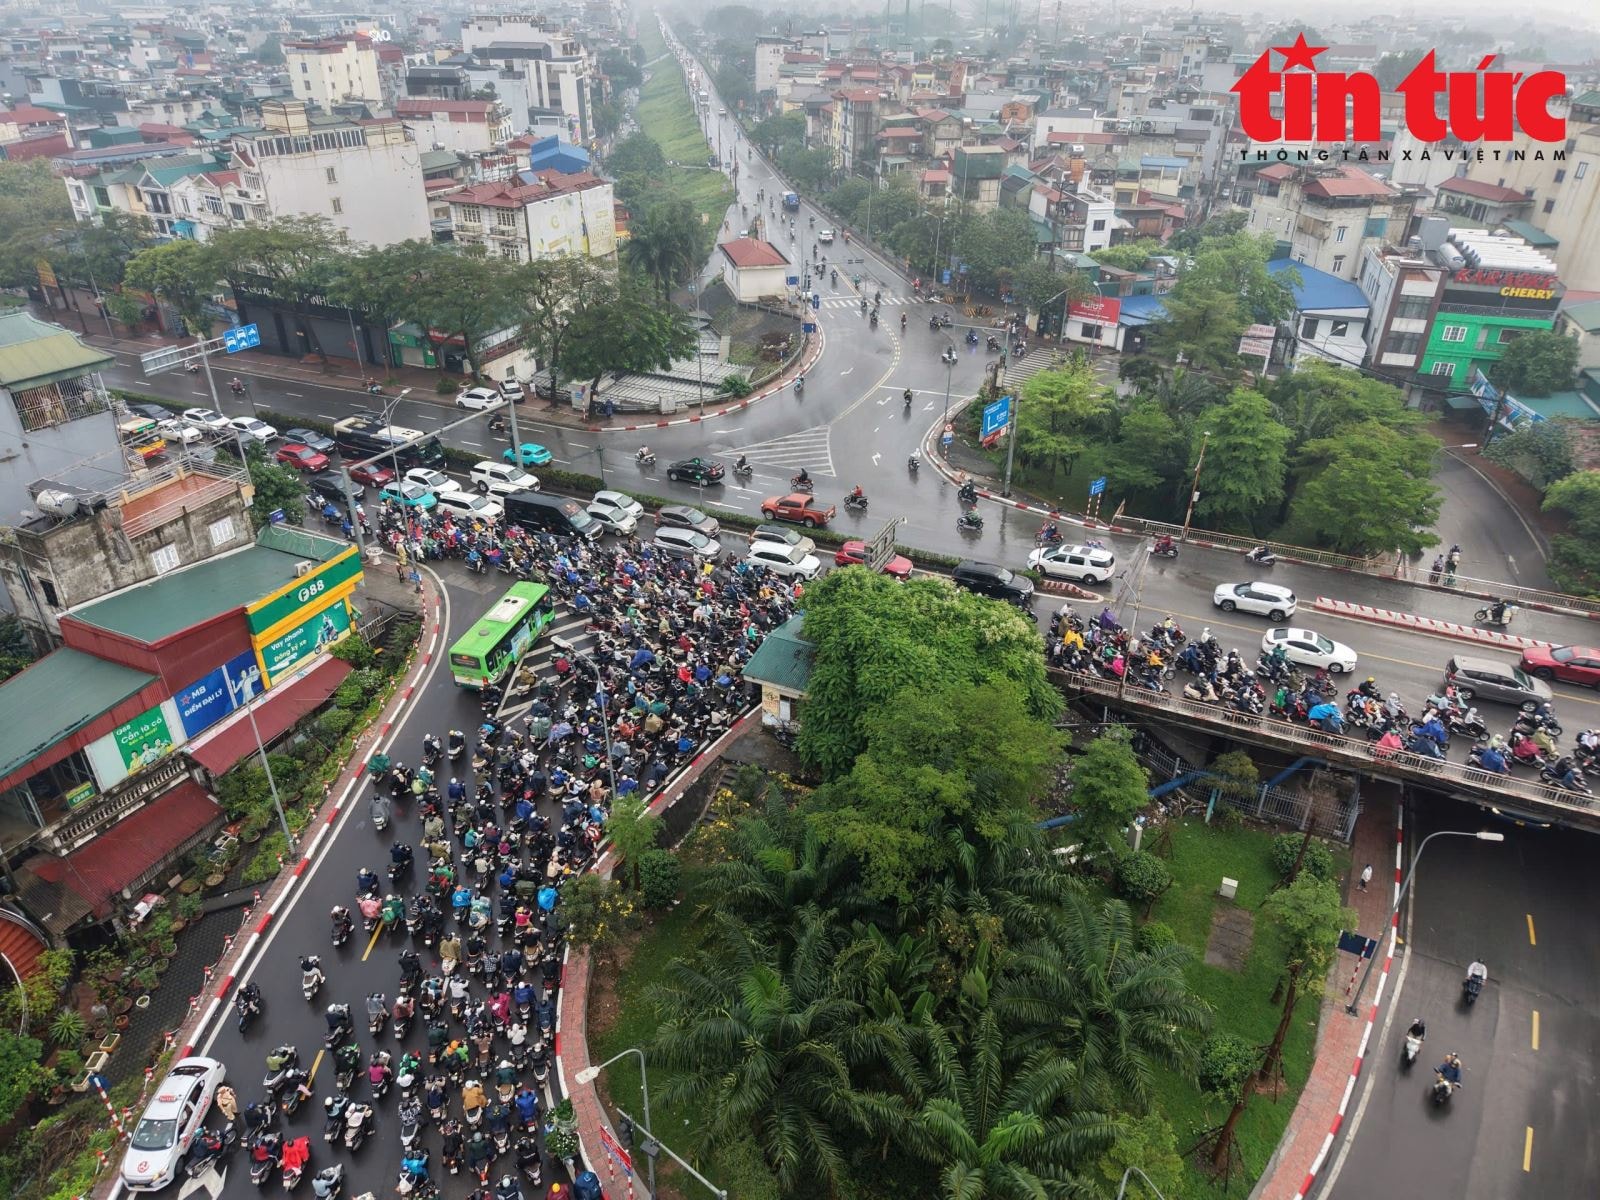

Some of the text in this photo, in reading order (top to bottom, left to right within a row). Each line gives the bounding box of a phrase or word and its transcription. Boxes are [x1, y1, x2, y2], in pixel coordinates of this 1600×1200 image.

[1453, 267, 1559, 290] KARAOKE
[1500, 286, 1555, 300] CHERRY
[298, 579, 325, 602] F88
[271, 628, 304, 651] Vay nhanh
[191, 685, 206, 699] MB
[202, 695, 215, 706] ĐẠI
[141, 722, 149, 732] là
